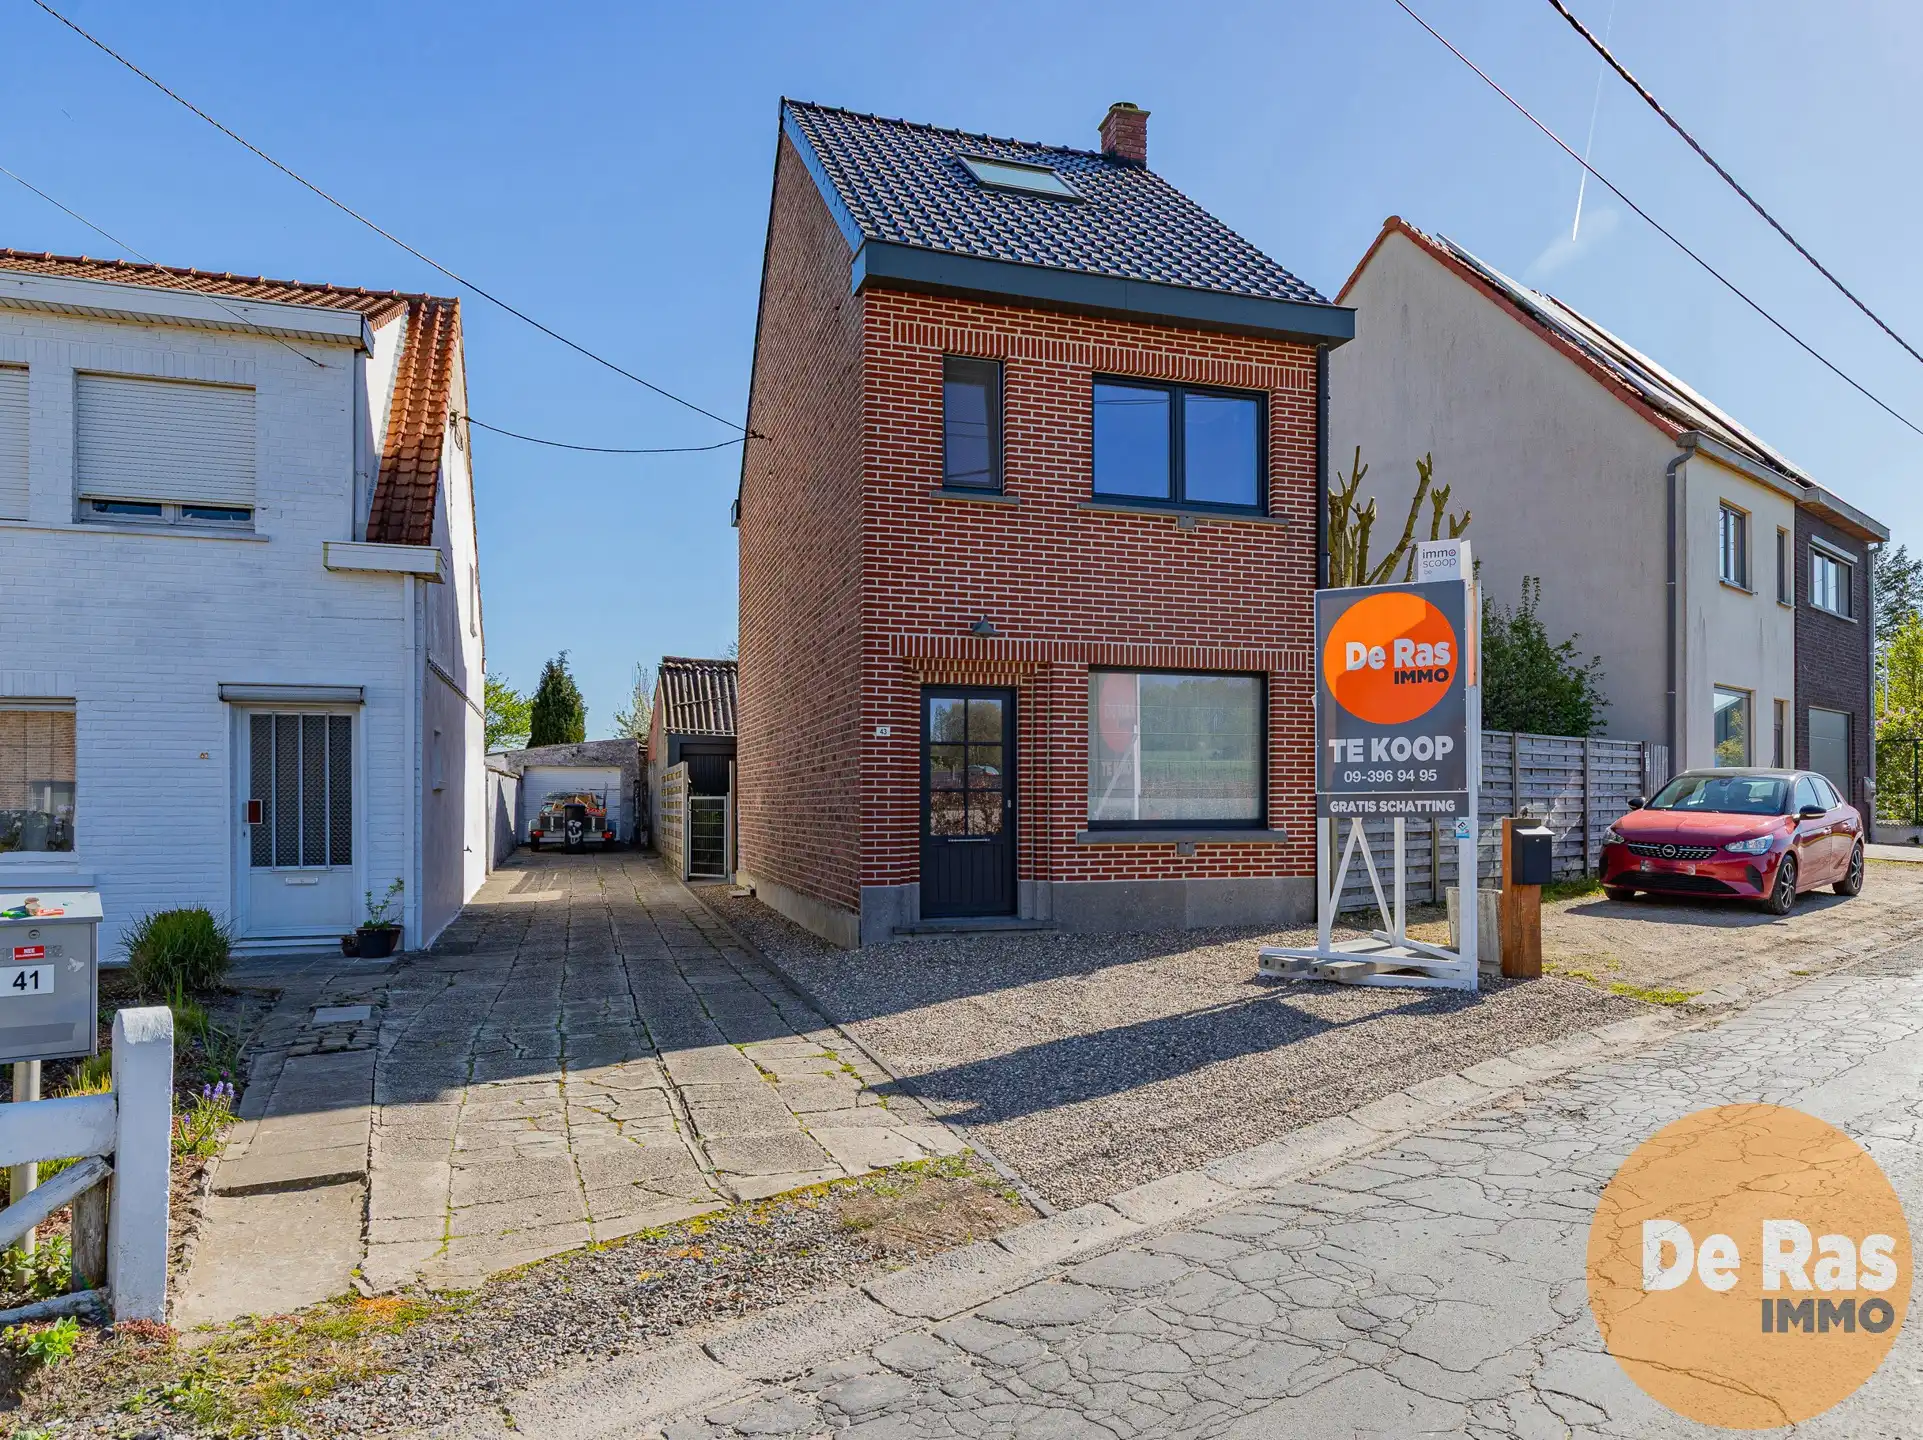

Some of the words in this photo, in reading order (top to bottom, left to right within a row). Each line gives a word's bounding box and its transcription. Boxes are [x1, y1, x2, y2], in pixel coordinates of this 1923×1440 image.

[1422, 549, 1457, 558] immo
[1422, 558, 1457, 568] scoop
[1345, 641, 1387, 671] De
[1393, 638, 1451, 668] Ras
[1394, 668, 1450, 684] IMMO
[1328, 738, 1364, 763] TE
[1371, 735, 1454, 762] KOOP
[1343, 770, 1393, 783] 09-396
[1397, 769, 1416, 781] 94
[1419, 769, 1438, 781] 95
[1329, 800, 1377, 813] GRATIS
[1379, 800, 1456, 812] SCHATTING
[12, 970, 39, 991] 41
